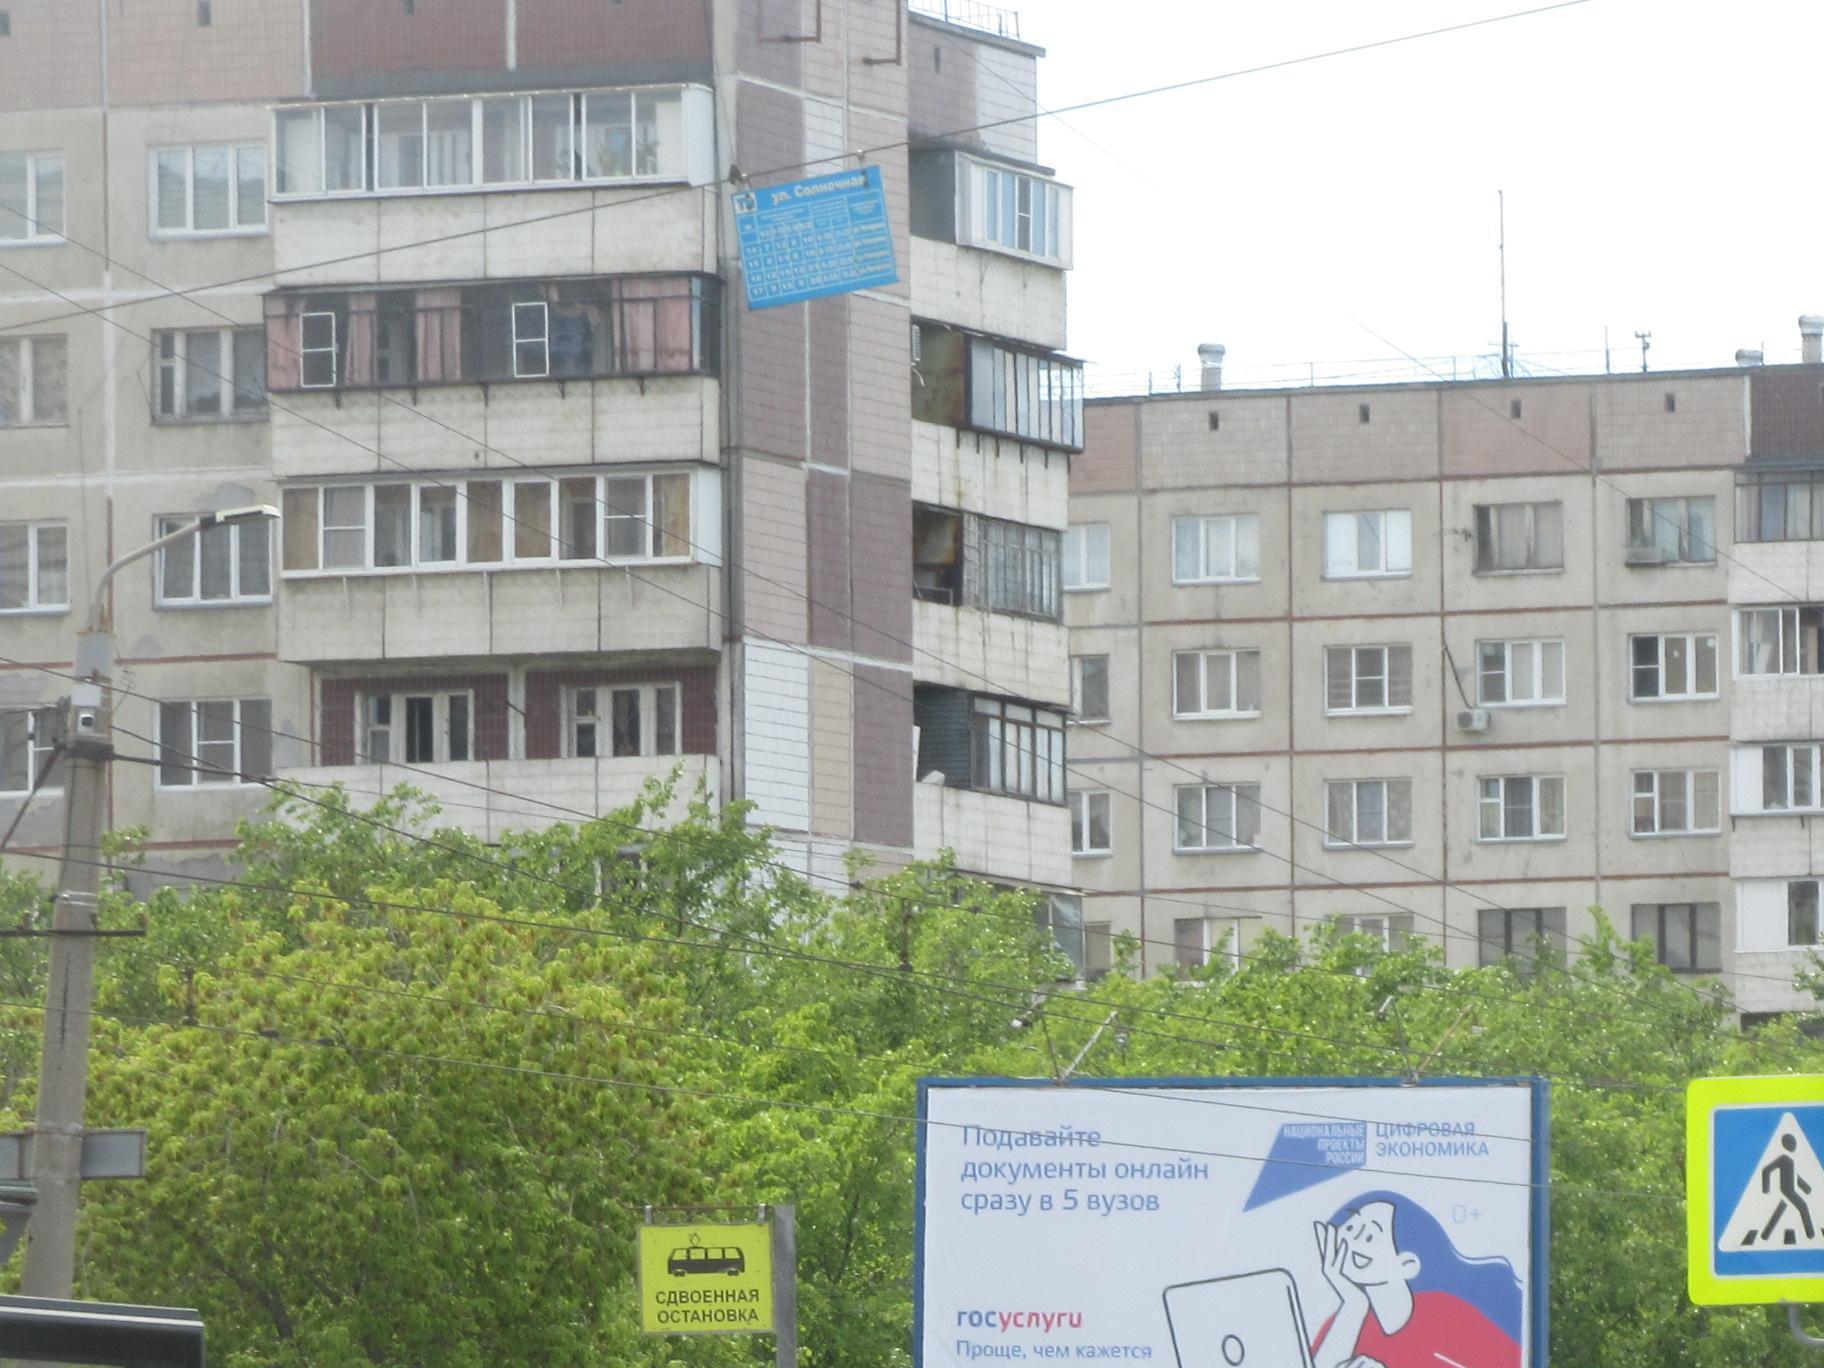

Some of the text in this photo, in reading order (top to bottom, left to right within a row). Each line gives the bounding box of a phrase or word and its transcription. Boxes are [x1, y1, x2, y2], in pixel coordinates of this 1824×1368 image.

[962, 1124, 1102, 1151] Подавайте
[1282, 1124, 1365, 1138] НАЦИОНАЛЬНЫЕ
[1375, 1122, 1475, 1139] ЦИФРОВАЯ
[1317, 1138, 1365, 1151] ПРОЕКТЫ
[1375, 1142, 1490, 1157] ЭКОНОМИКА
[1325, 1152, 1365, 1165] РОССИИ
[960, 1158, 1209, 1185] документы онлайн
[960, 1189, 1160, 1216] сразу в 5 вузов
[1451, 1205, 1483, 1224] 0+
[655, 1289, 759, 1306] СДВОЕННАЯ
[657, 1309, 759, 1325] ОСТАНОВКА
[957, 1310, 1083, 1333] госуслуги
[956, 1340, 1153, 1361] Проще, чем кажется
